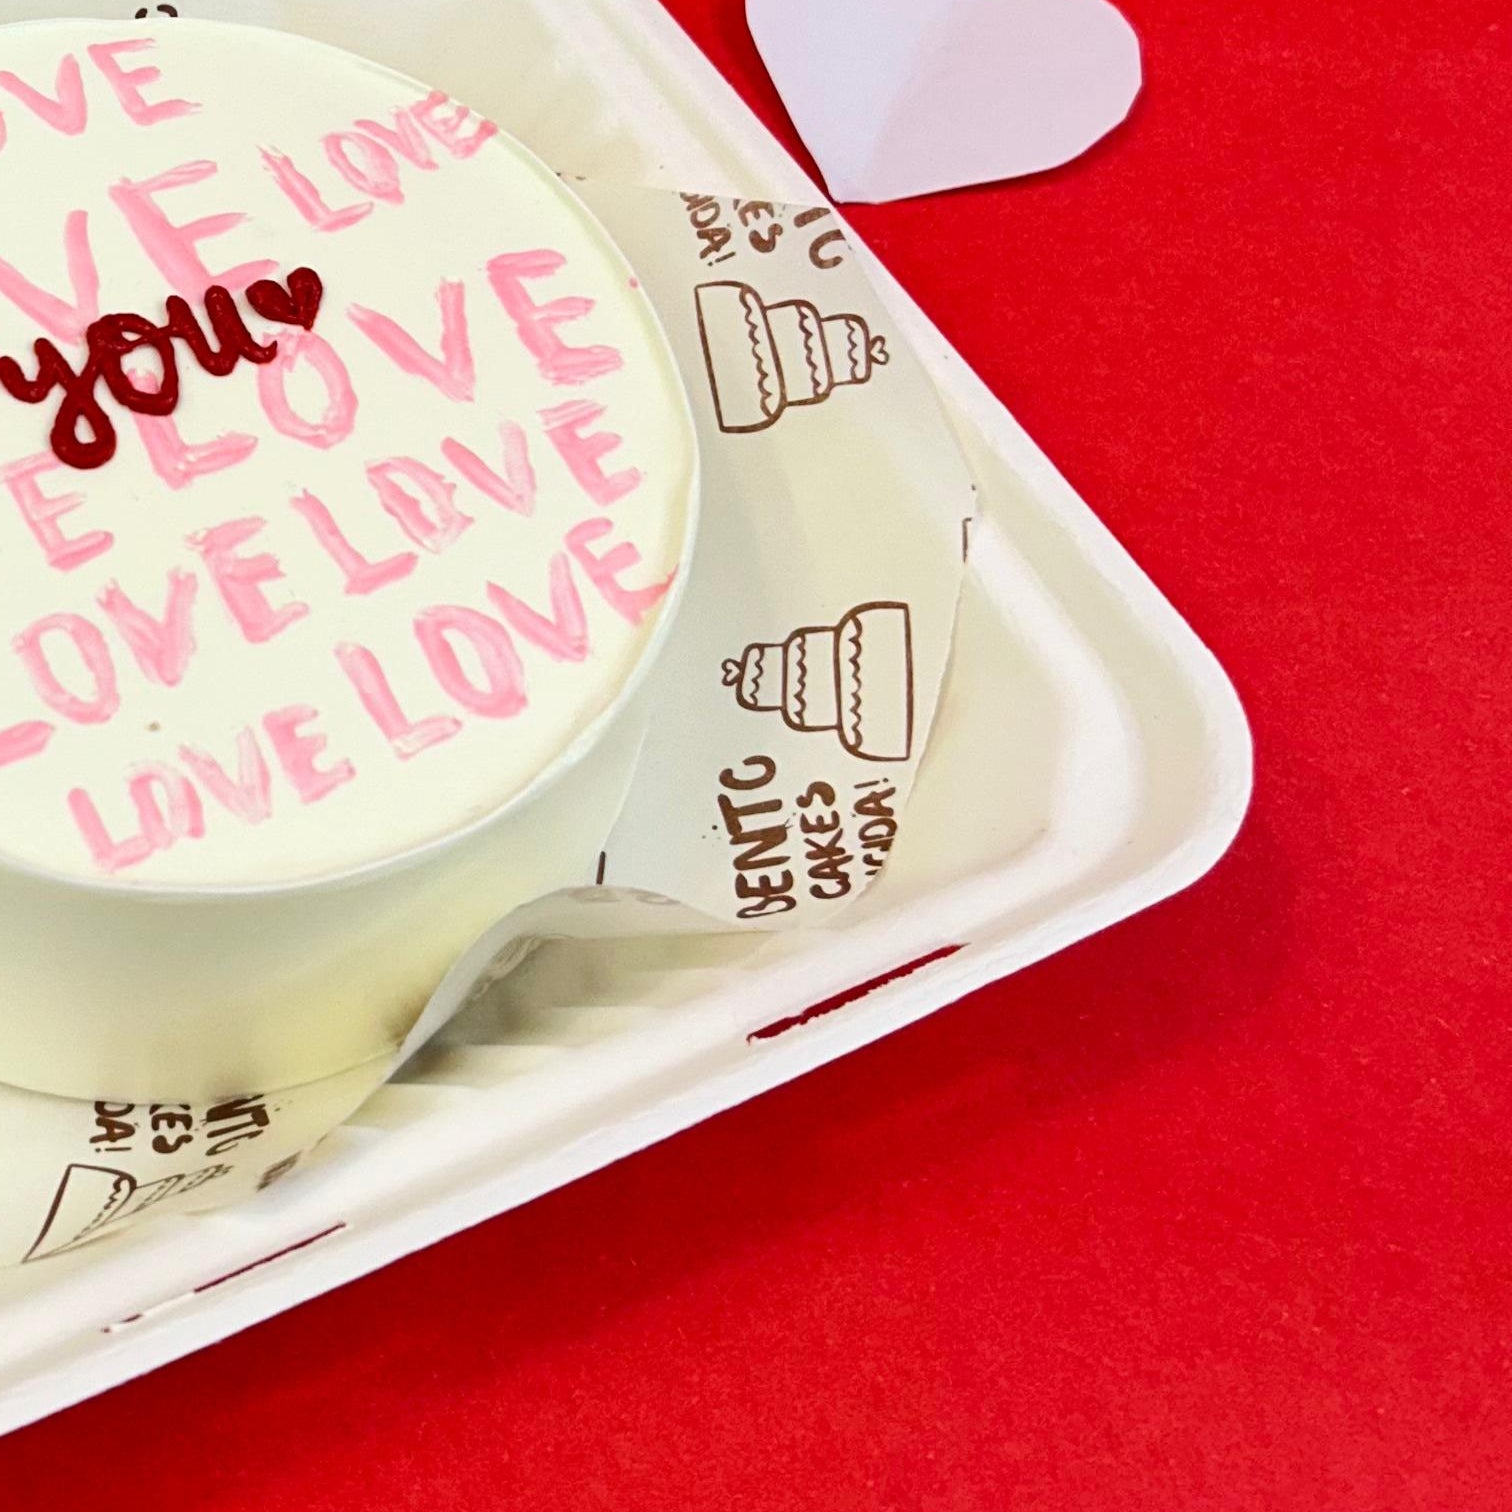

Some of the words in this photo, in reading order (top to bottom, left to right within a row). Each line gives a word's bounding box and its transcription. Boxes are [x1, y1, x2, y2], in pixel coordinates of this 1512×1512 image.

[256, 89, 498, 232] LOVE
[124, 248, 624, 490] LOVE
[289, 397, 645, 595] LOVE
[67, 703, 357, 874] LOVE
[333, 517, 679, 760] LOVE
[796, 781, 854, 899] CAKES
